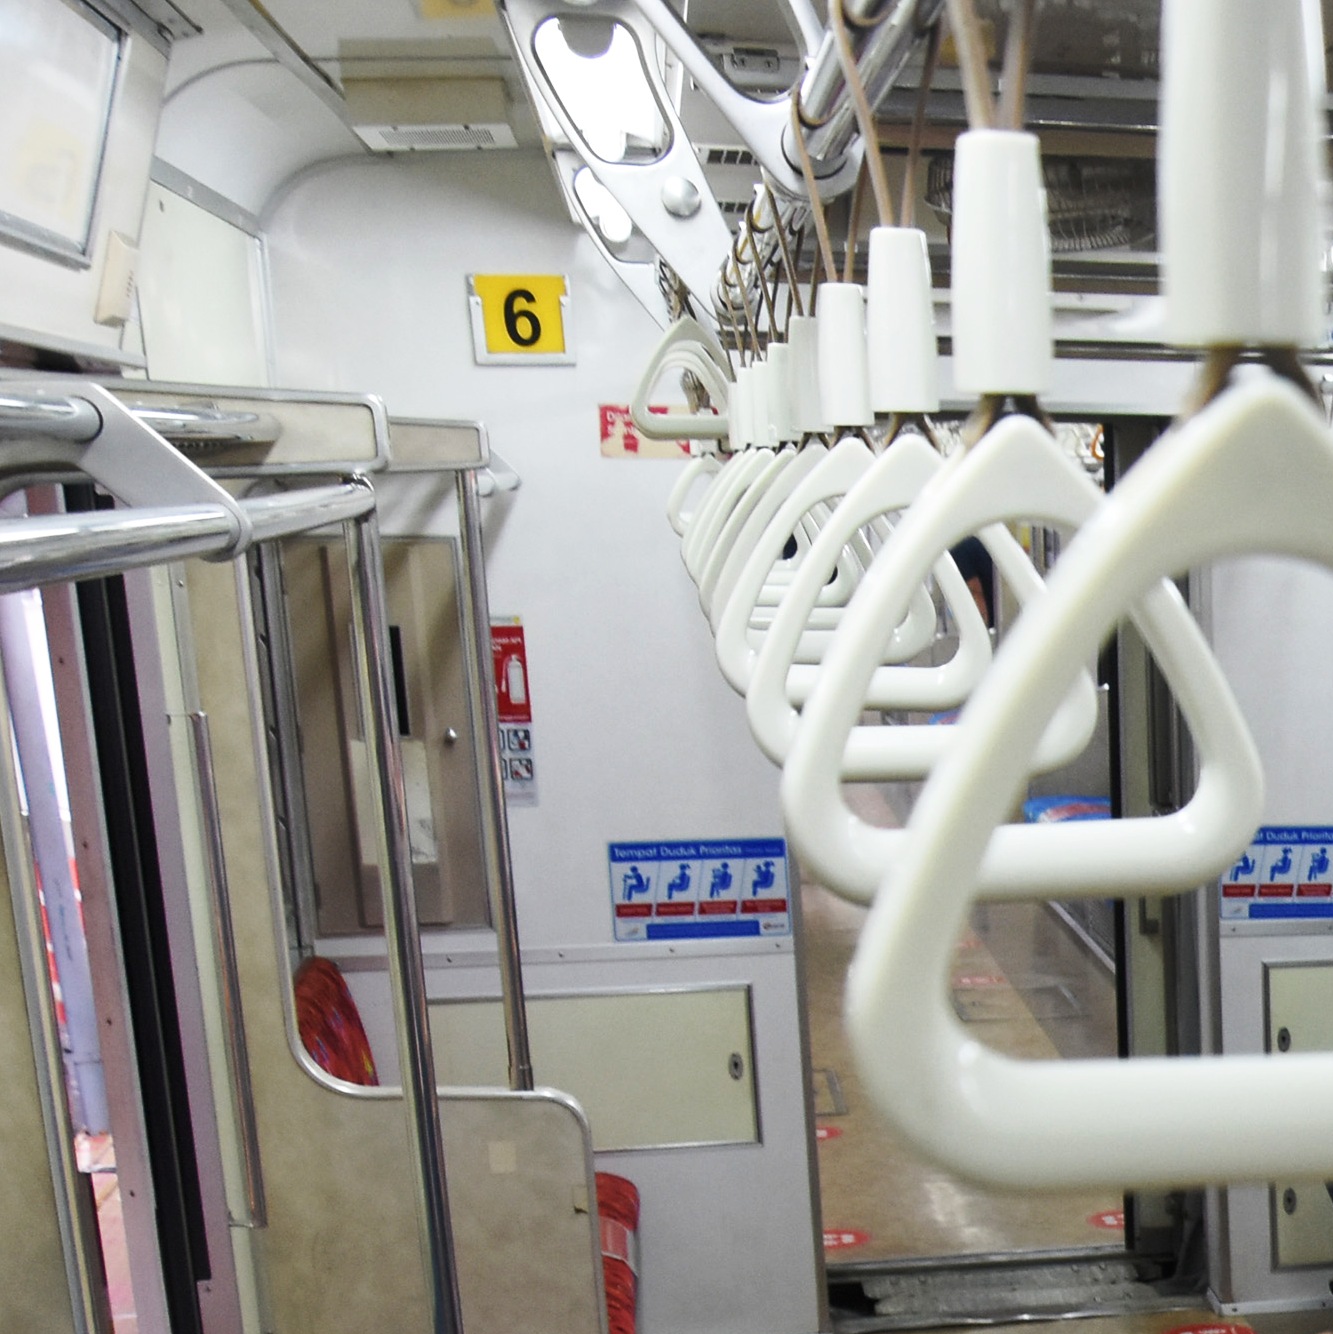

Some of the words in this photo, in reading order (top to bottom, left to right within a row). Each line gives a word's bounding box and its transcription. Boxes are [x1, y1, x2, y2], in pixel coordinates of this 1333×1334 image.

[503, 287, 543, 348] 6
[1265, 831, 1299, 841] Duduk
[613, 847, 657, 859] Tempat
[660, 845, 697, 857] Duduk
[699, 844, 742, 855] Prioritas
